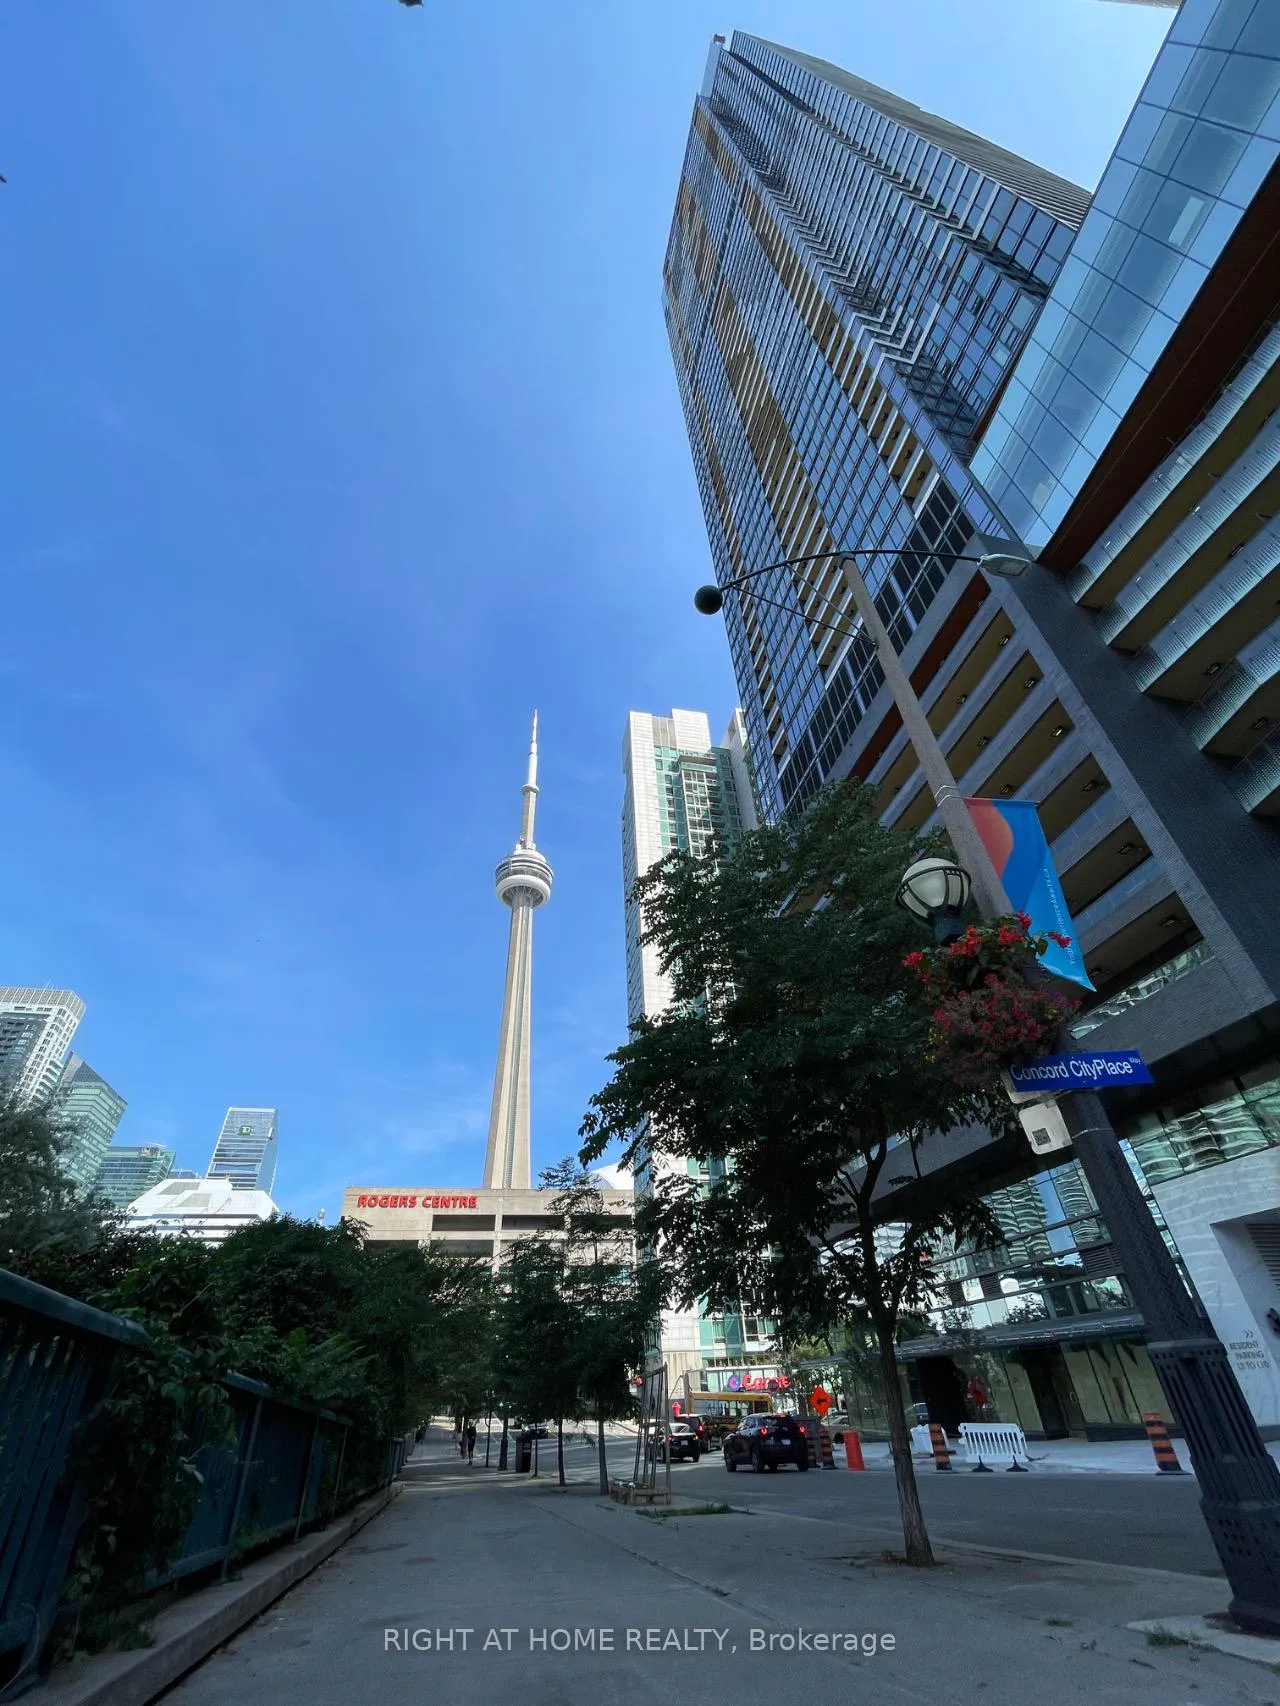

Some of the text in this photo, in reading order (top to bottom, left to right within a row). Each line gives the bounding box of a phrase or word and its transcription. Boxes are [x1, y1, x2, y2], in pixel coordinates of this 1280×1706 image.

[1010, 1060, 1069, 1081] Concord
[1069, 1058, 1133, 1080] CityPlace
[357, 1194, 478, 1208] ROGERS CENTRE
